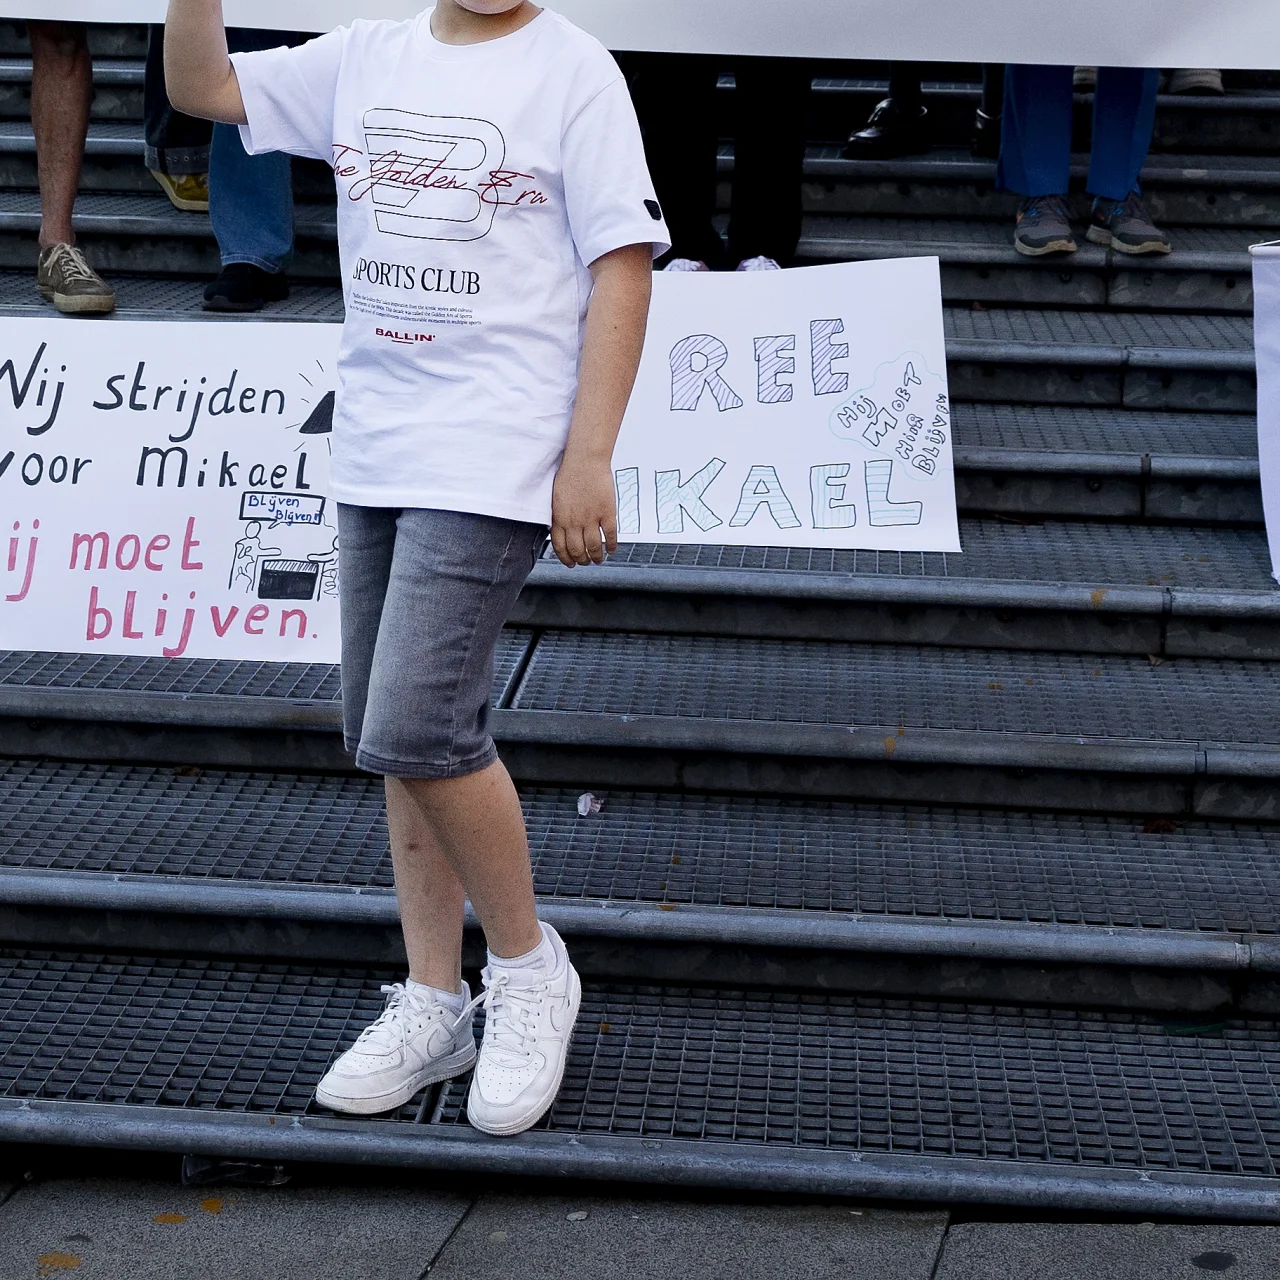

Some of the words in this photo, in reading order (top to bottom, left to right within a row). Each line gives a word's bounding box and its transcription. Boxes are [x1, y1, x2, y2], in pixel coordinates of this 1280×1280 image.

[348, 150, 467, 202] Golden
[420, 267, 481, 295] CLUB
[93, 360, 286, 443] strijden
[837, 395, 877, 429] Hij
[862, 361, 922, 447] MOET
[615, 457, 923, 534] IKAEL
[69, 516, 204, 572] moet
